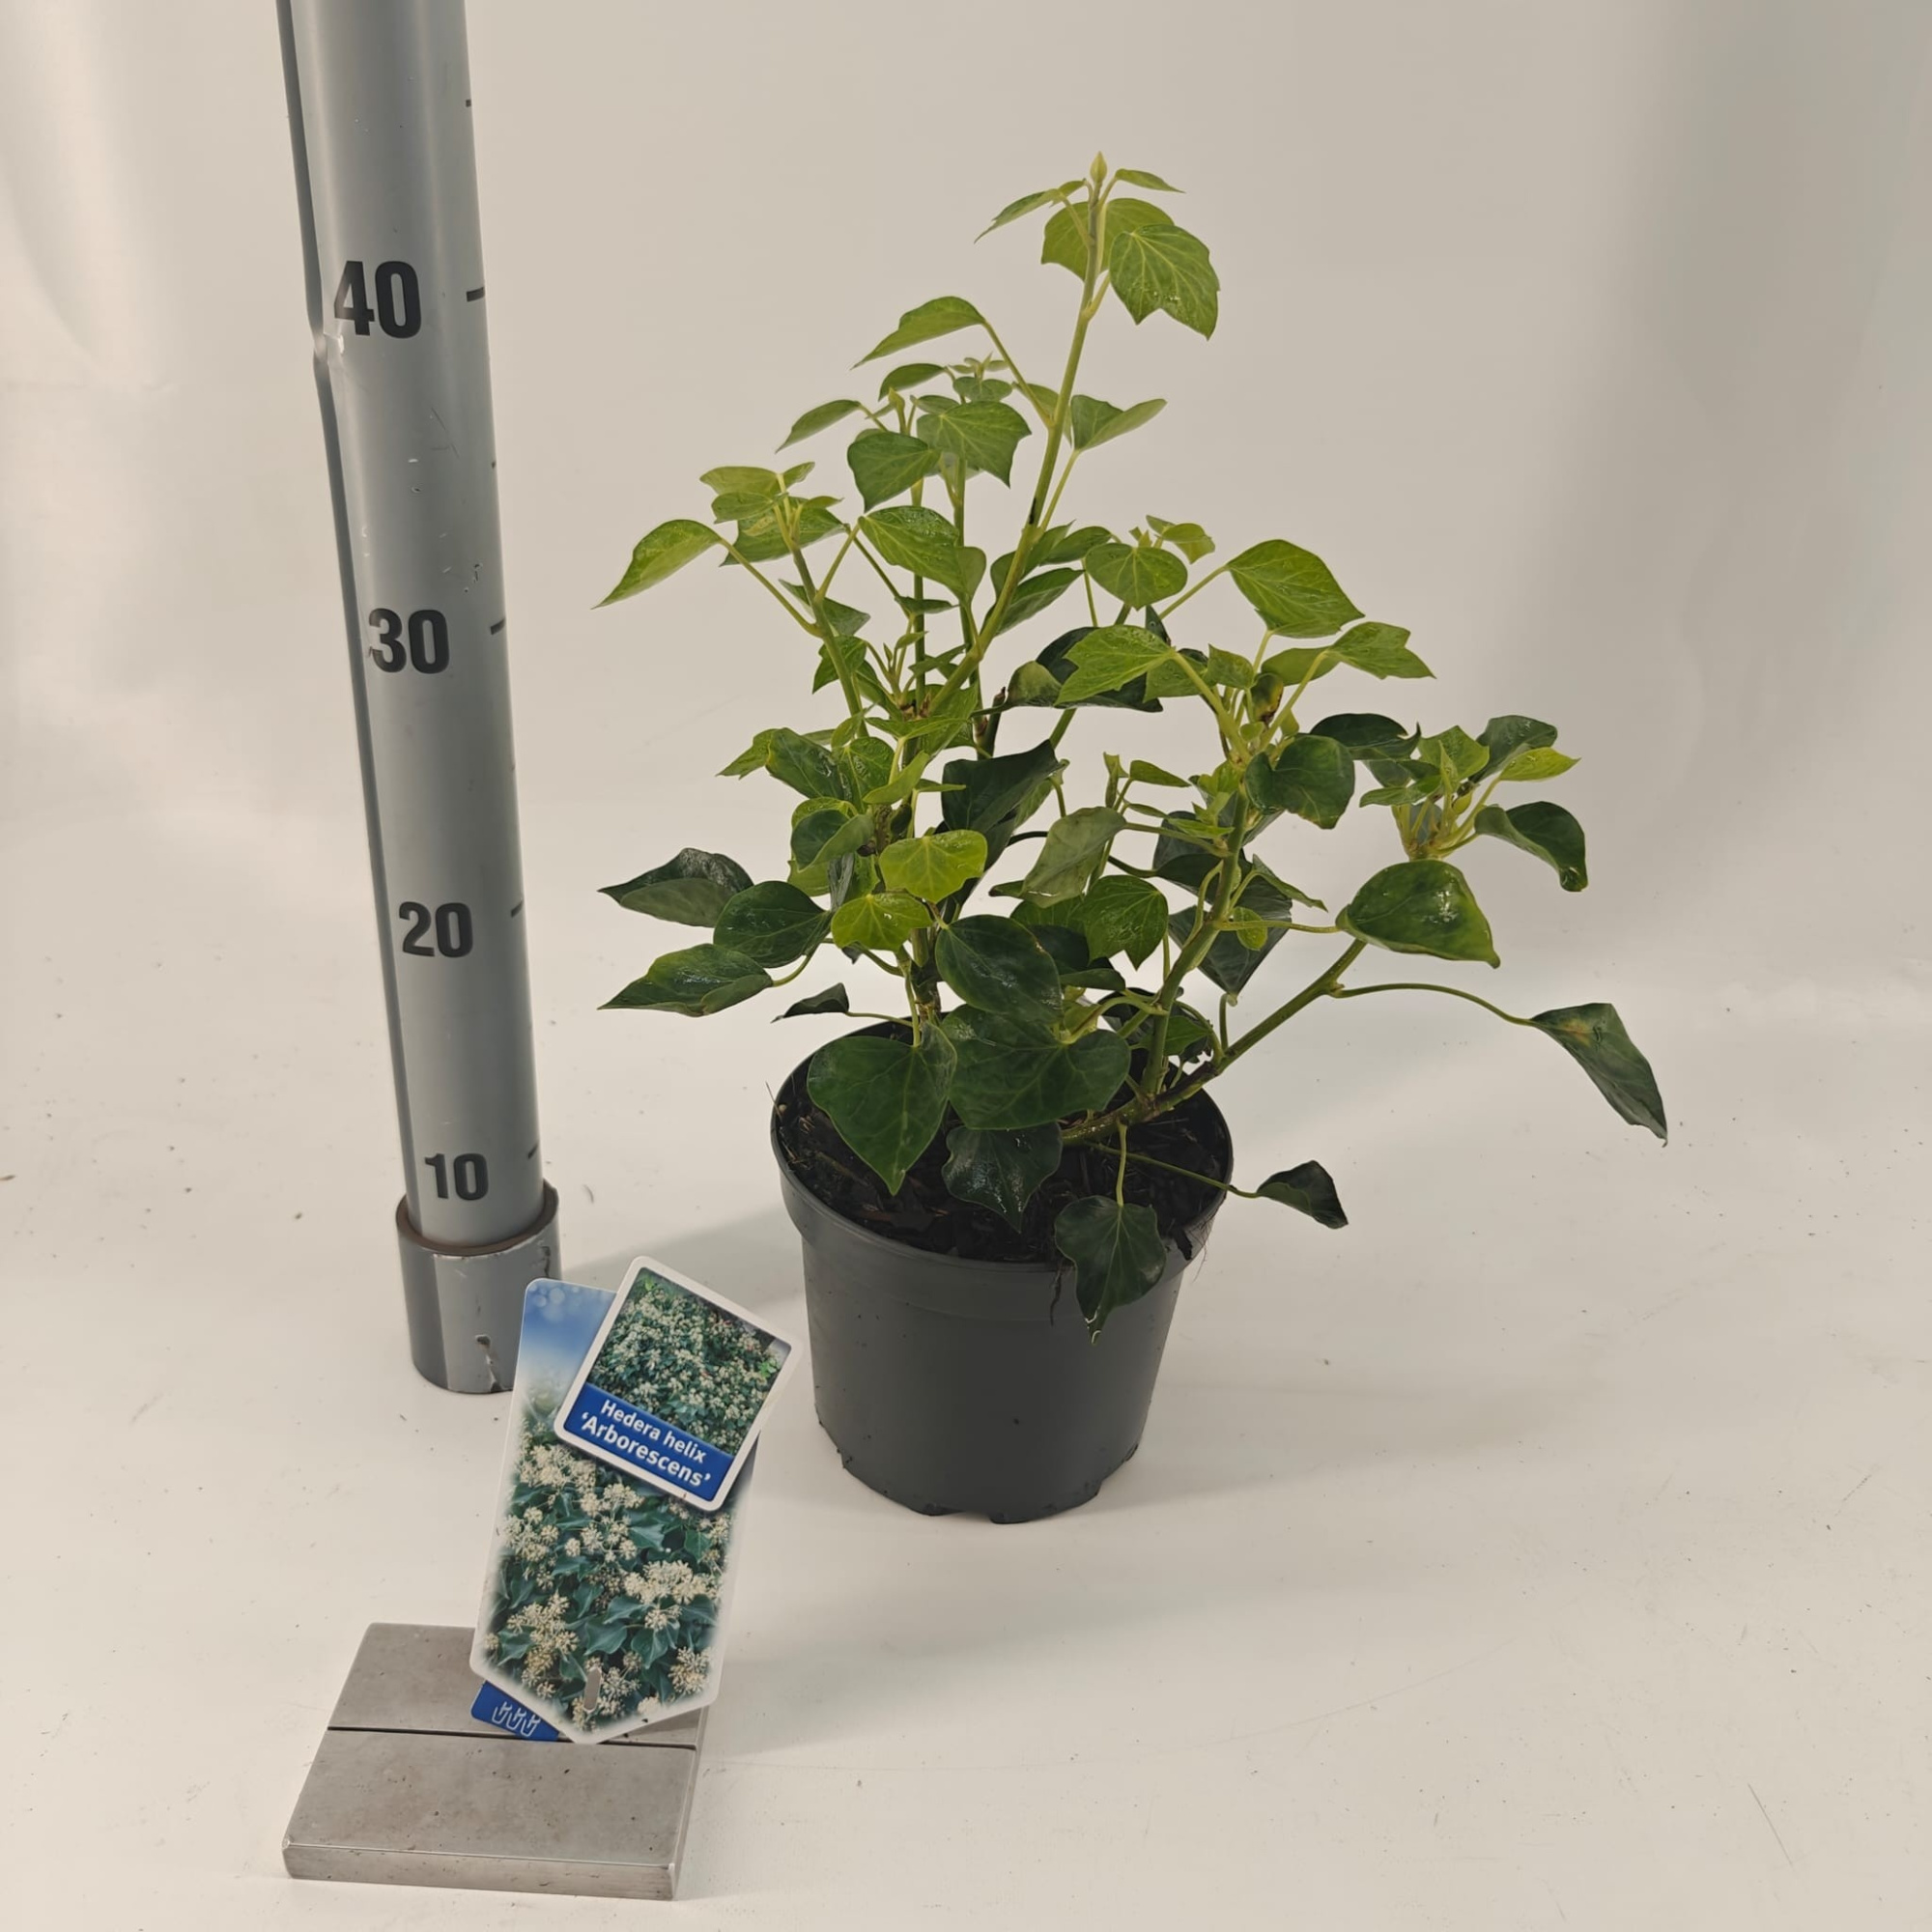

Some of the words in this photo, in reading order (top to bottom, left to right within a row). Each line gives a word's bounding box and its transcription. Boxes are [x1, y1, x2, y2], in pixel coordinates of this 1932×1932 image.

[334, 260, 422, 339] 40
[368, 608, 450, 674] 30
[398, 900, 473, 958] 20
[425, 1152, 489, 1202] 10
[582, 1411, 711, 1487] ‘Arborescens’
[601, 1399, 661, 1440] Hedera
[663, 1431, 707, 1463] helix
